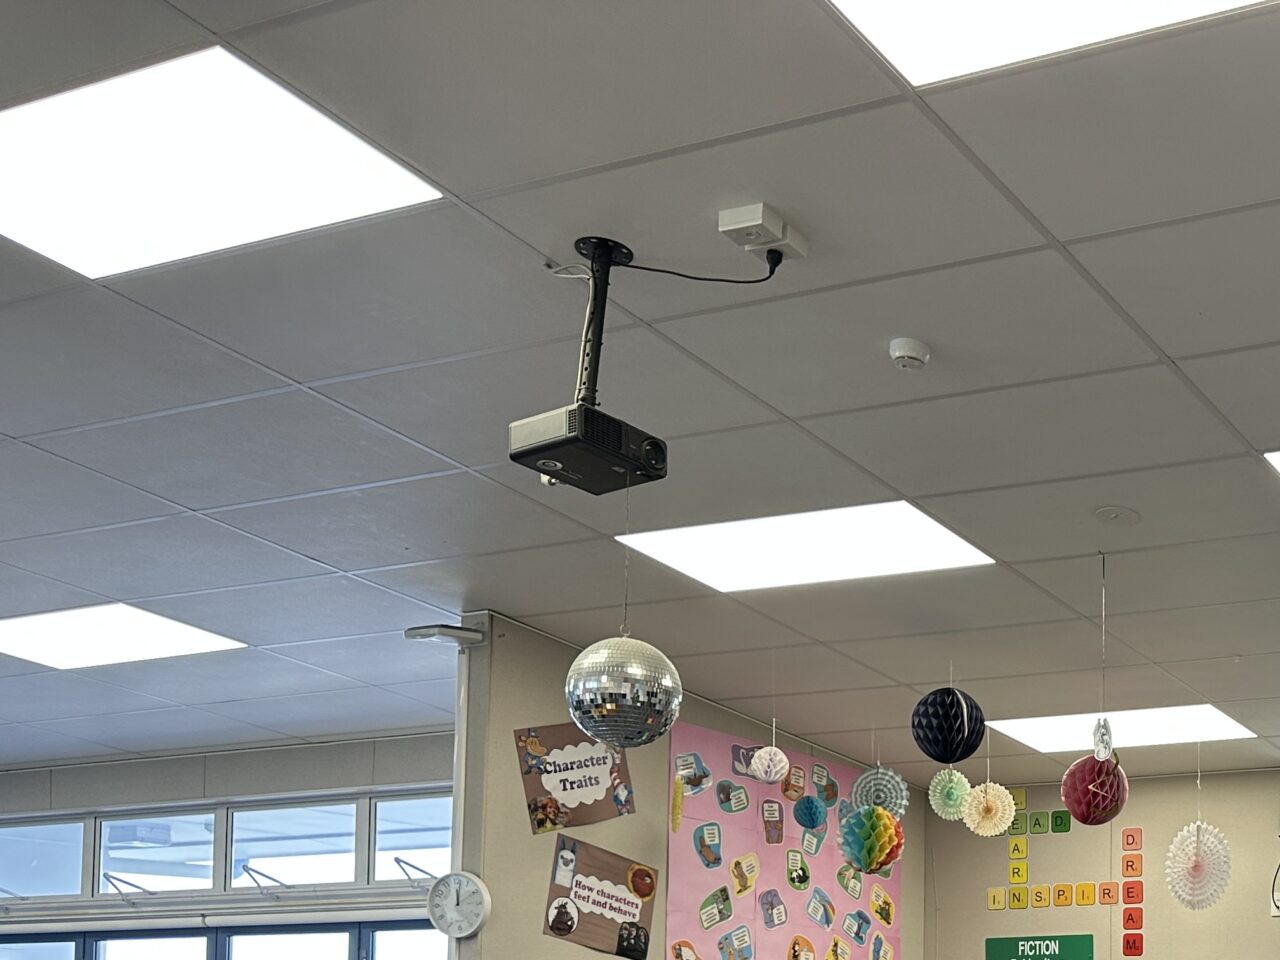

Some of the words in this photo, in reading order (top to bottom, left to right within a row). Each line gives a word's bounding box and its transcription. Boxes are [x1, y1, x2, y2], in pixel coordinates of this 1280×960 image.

[544, 755, 608, 775] Character
[560, 775, 600, 791] Traits
[575, 879, 595, 892] How
[596, 889, 639, 909] characters
[574, 891, 590, 903] feel
[591, 898, 607, 910] and
[608, 903, 637, 919] behave
[1018, 940, 1059, 955] FICTION
